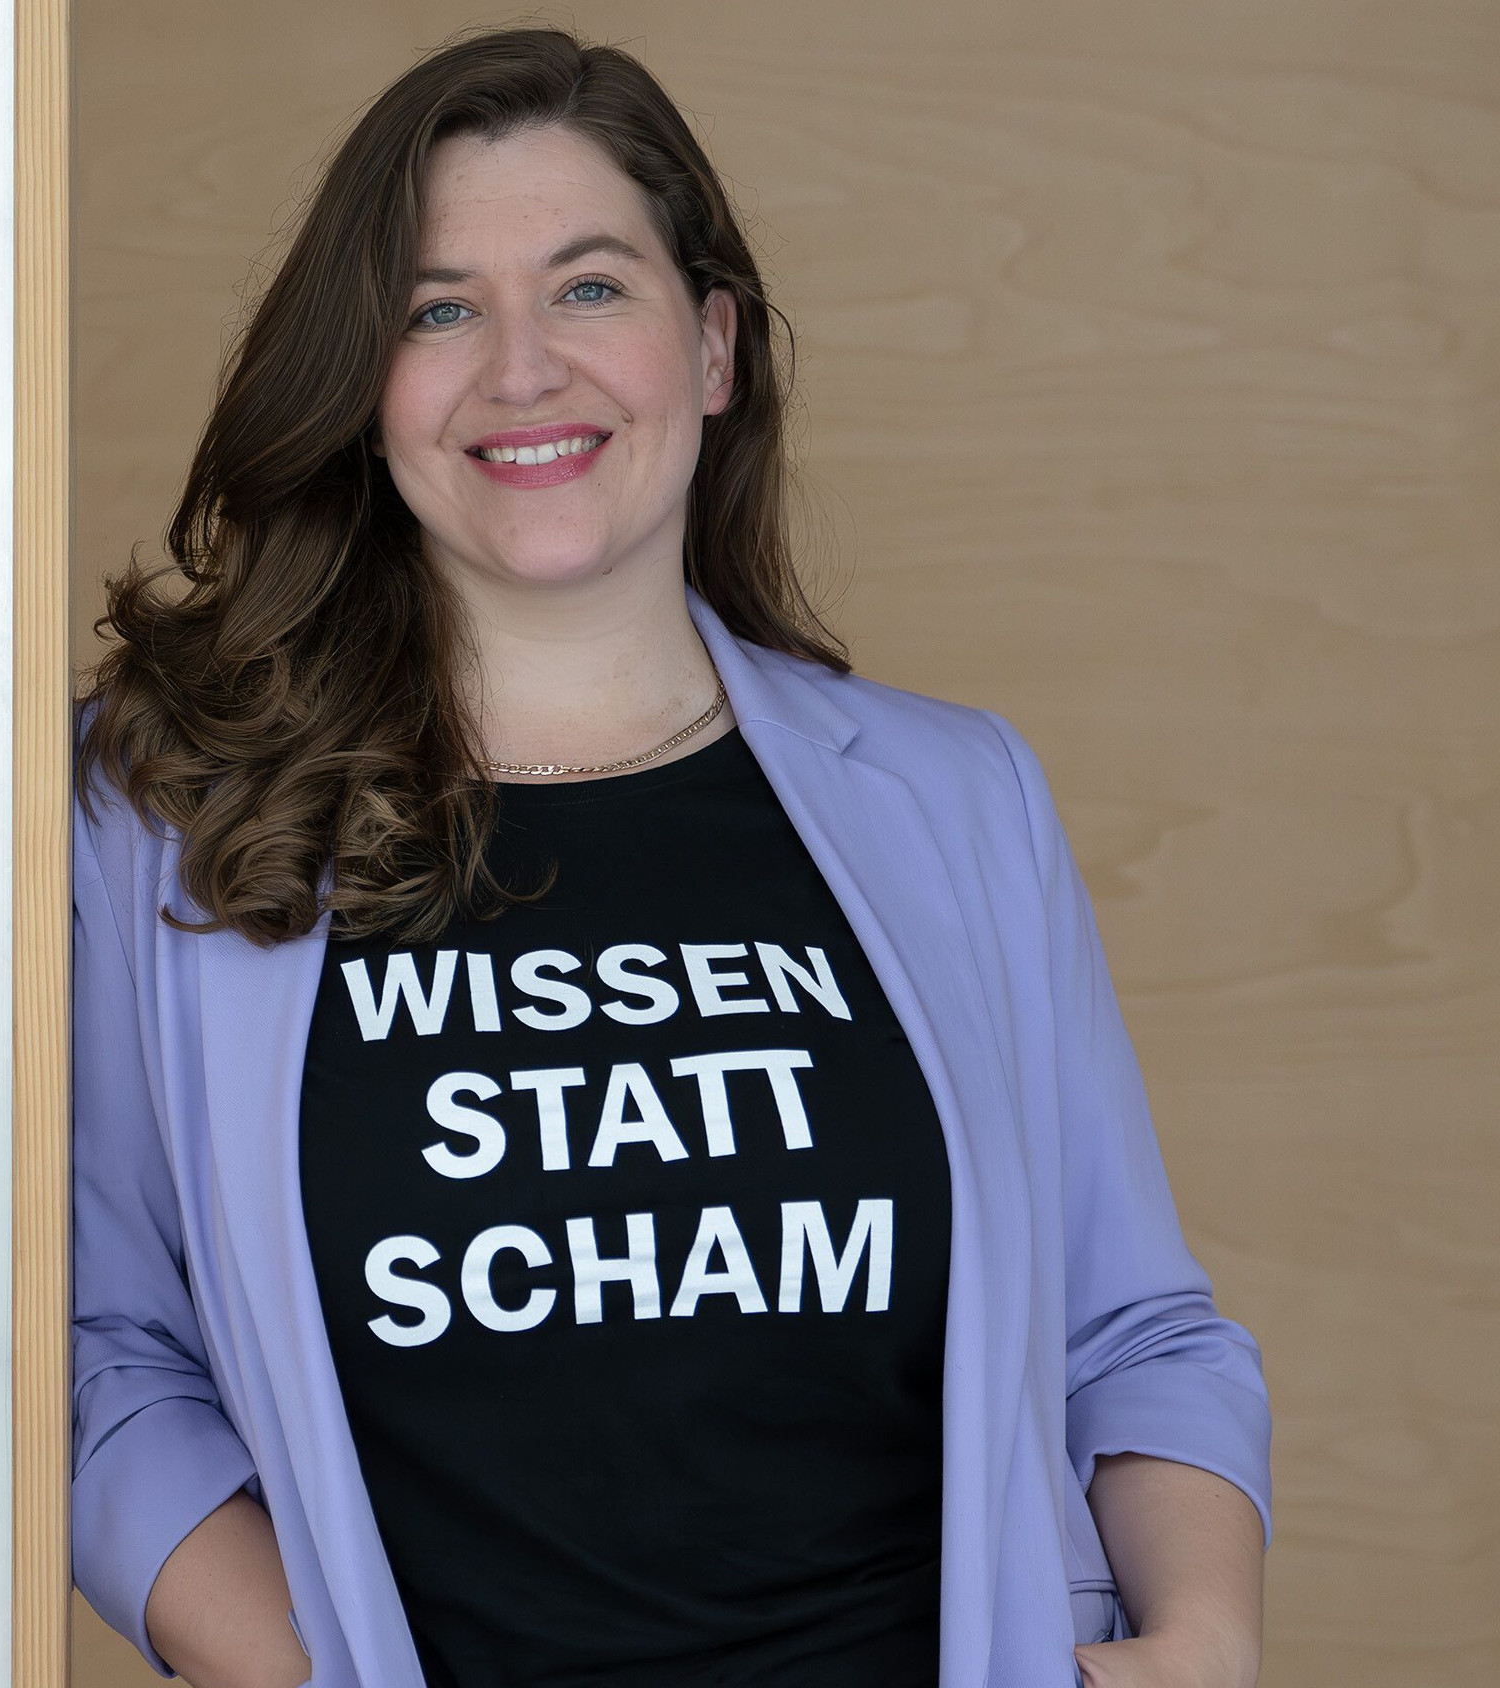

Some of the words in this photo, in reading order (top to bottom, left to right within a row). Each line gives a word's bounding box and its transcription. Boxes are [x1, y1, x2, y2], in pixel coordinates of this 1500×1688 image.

[340, 942, 853, 1041] WISSEN
[421, 1050, 814, 1178] STATT
[364, 1199, 893, 1346] SCHAM
